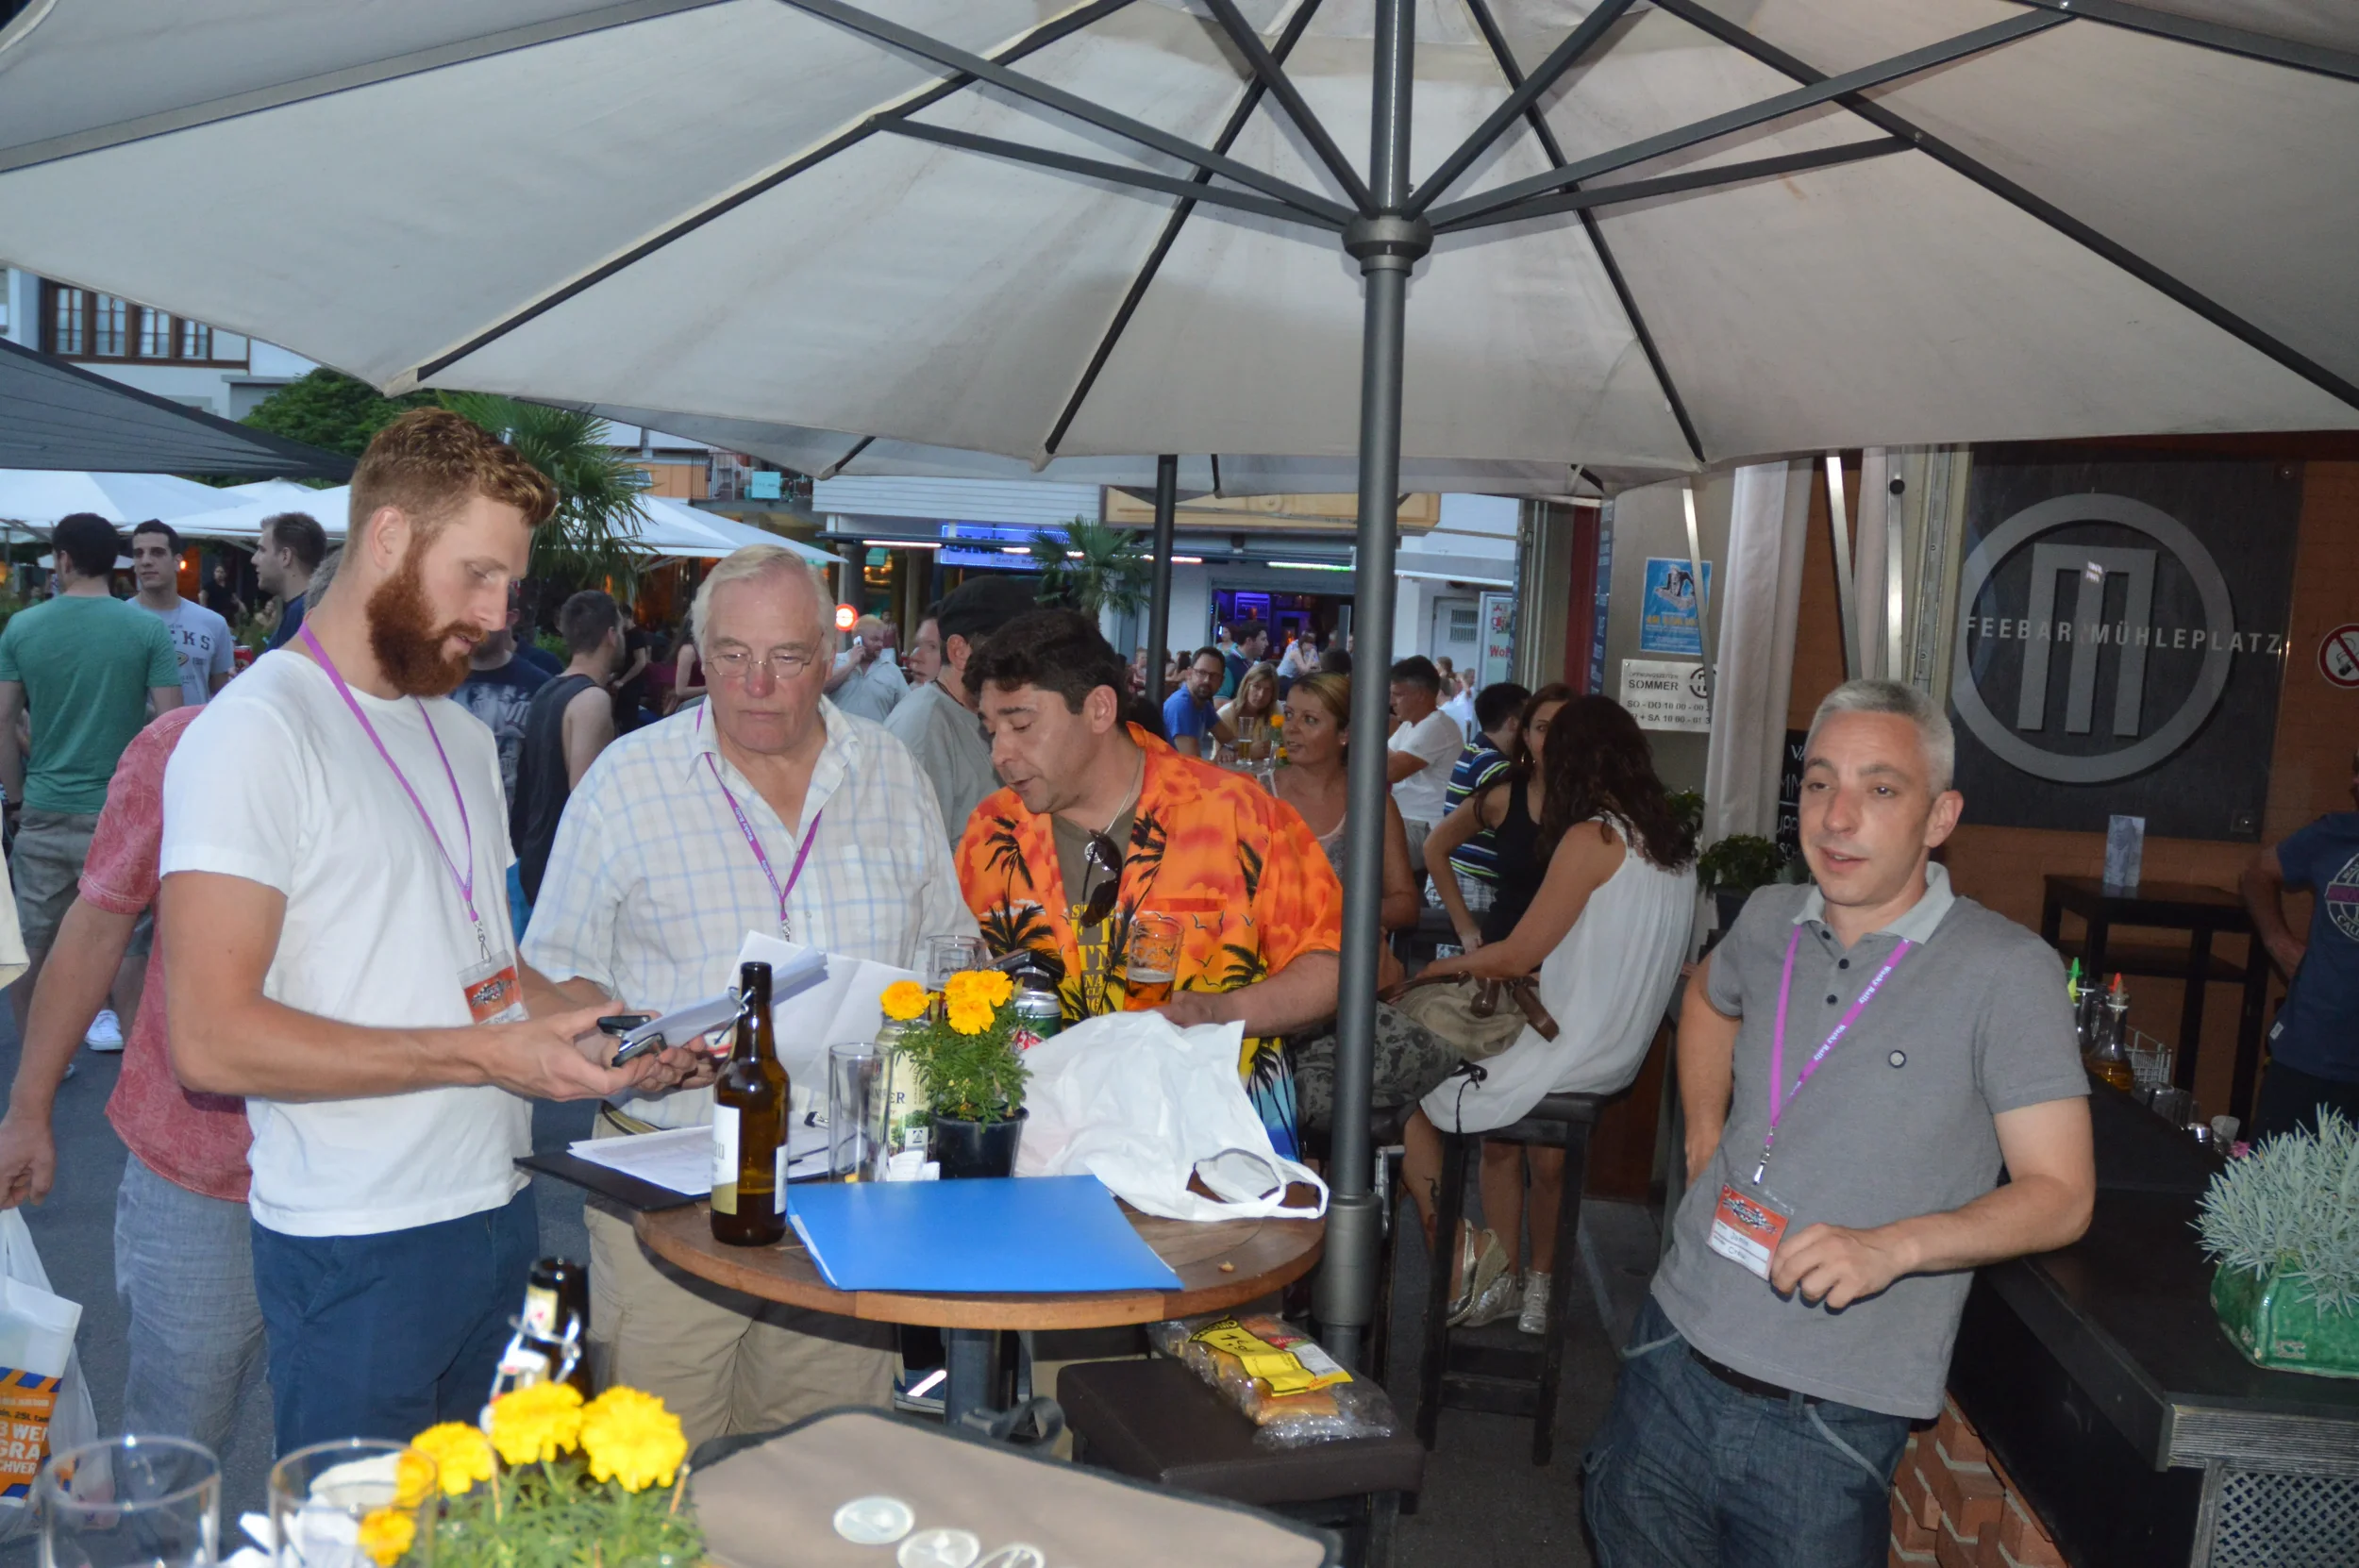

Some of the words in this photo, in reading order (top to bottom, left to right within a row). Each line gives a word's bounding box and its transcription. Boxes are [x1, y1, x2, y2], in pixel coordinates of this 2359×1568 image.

[2090, 620, 2282, 654] MÜHLEPLATZ
[1629, 679, 1679, 691] SOMMER
[1872, 965, 1892, 987] Wacky
[1858, 986, 1876, 1005] Rally
[1827, 1024, 1847, 1044] Wacky
[1814, 1043, 1831, 1061] Rally
